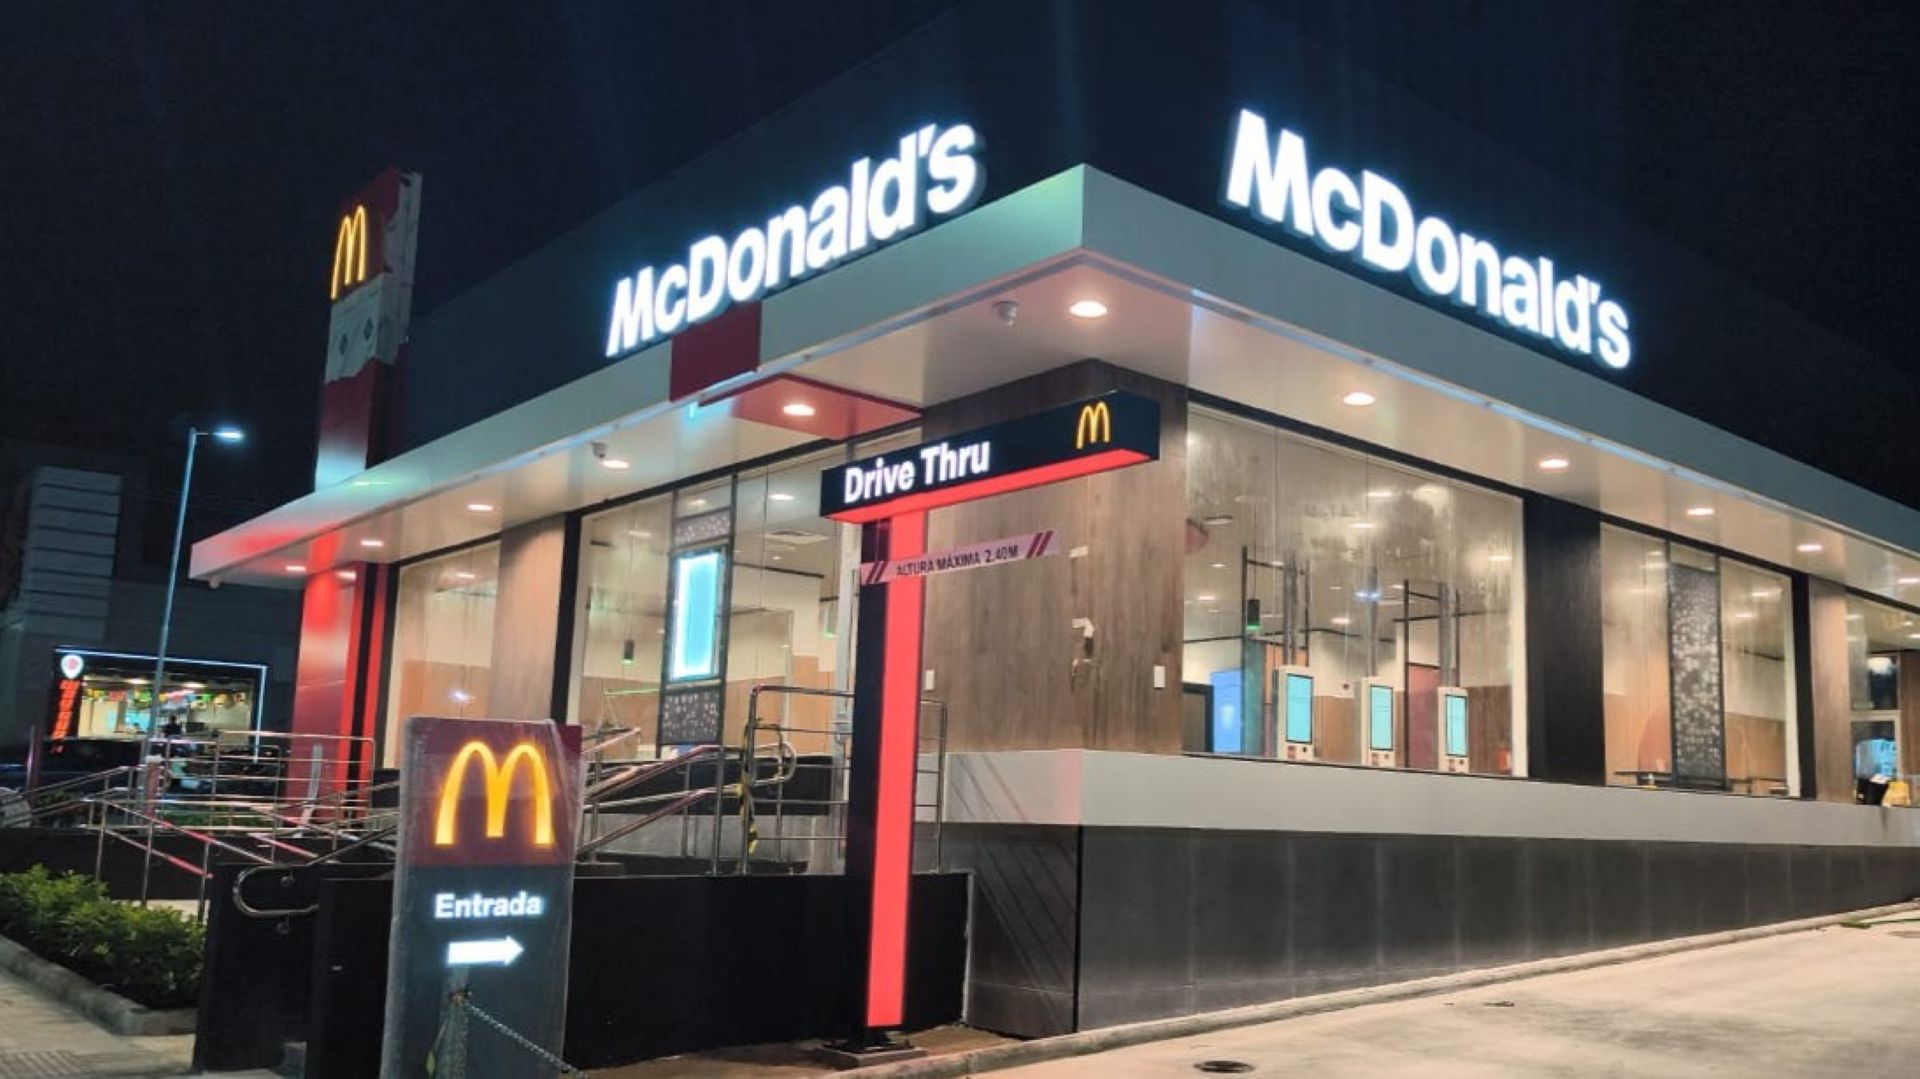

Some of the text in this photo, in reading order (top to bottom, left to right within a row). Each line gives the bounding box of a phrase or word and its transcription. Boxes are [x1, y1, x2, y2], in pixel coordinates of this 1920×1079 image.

[605, 123, 980, 358] McDonald's
[1226, 108, 1631, 369] McDonald's
[844, 458, 915, 504] Drive
[921, 441, 990, 485] Thru
[896, 560, 934, 576] ALTURA
[434, 891, 543, 918] Entrada
